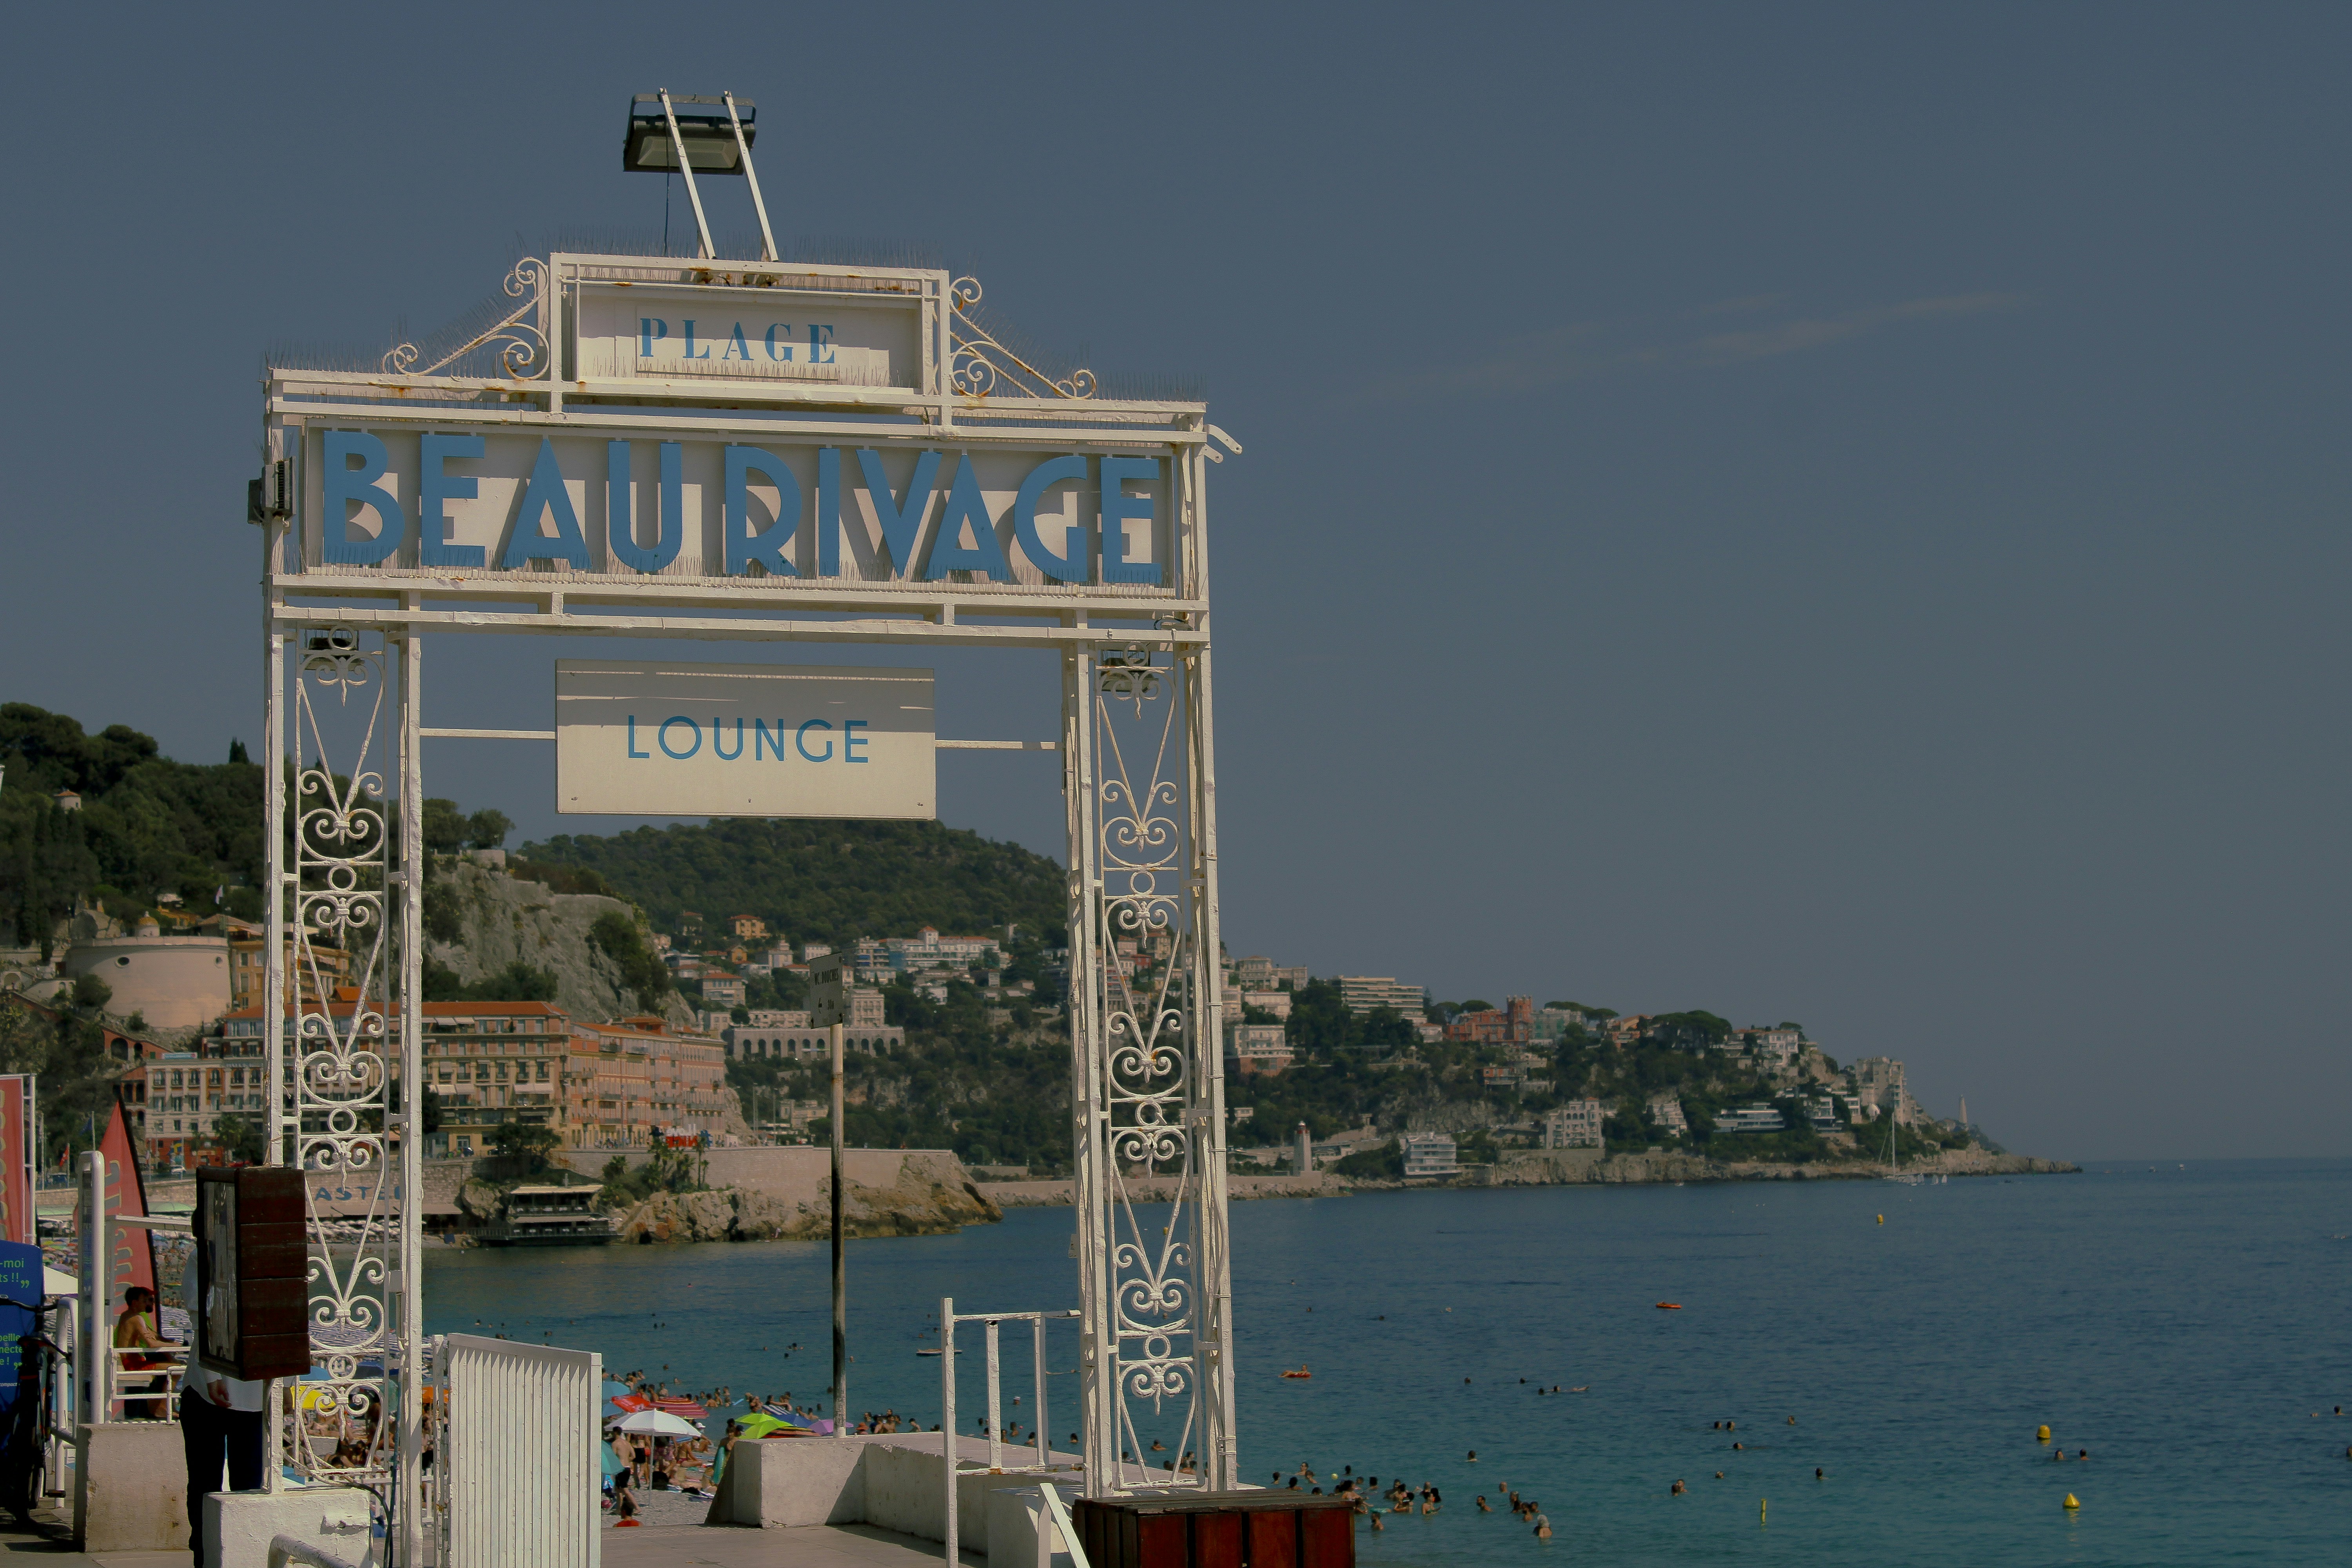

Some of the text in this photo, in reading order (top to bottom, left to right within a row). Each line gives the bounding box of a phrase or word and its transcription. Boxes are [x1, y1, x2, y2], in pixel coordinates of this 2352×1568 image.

[640, 318, 835, 364] PLAGE
[323, 431, 1162, 584] BEAU RIVAGE
[628, 715, 869, 763] LOUNGE
[306, 1186, 400, 1200] ASTE
